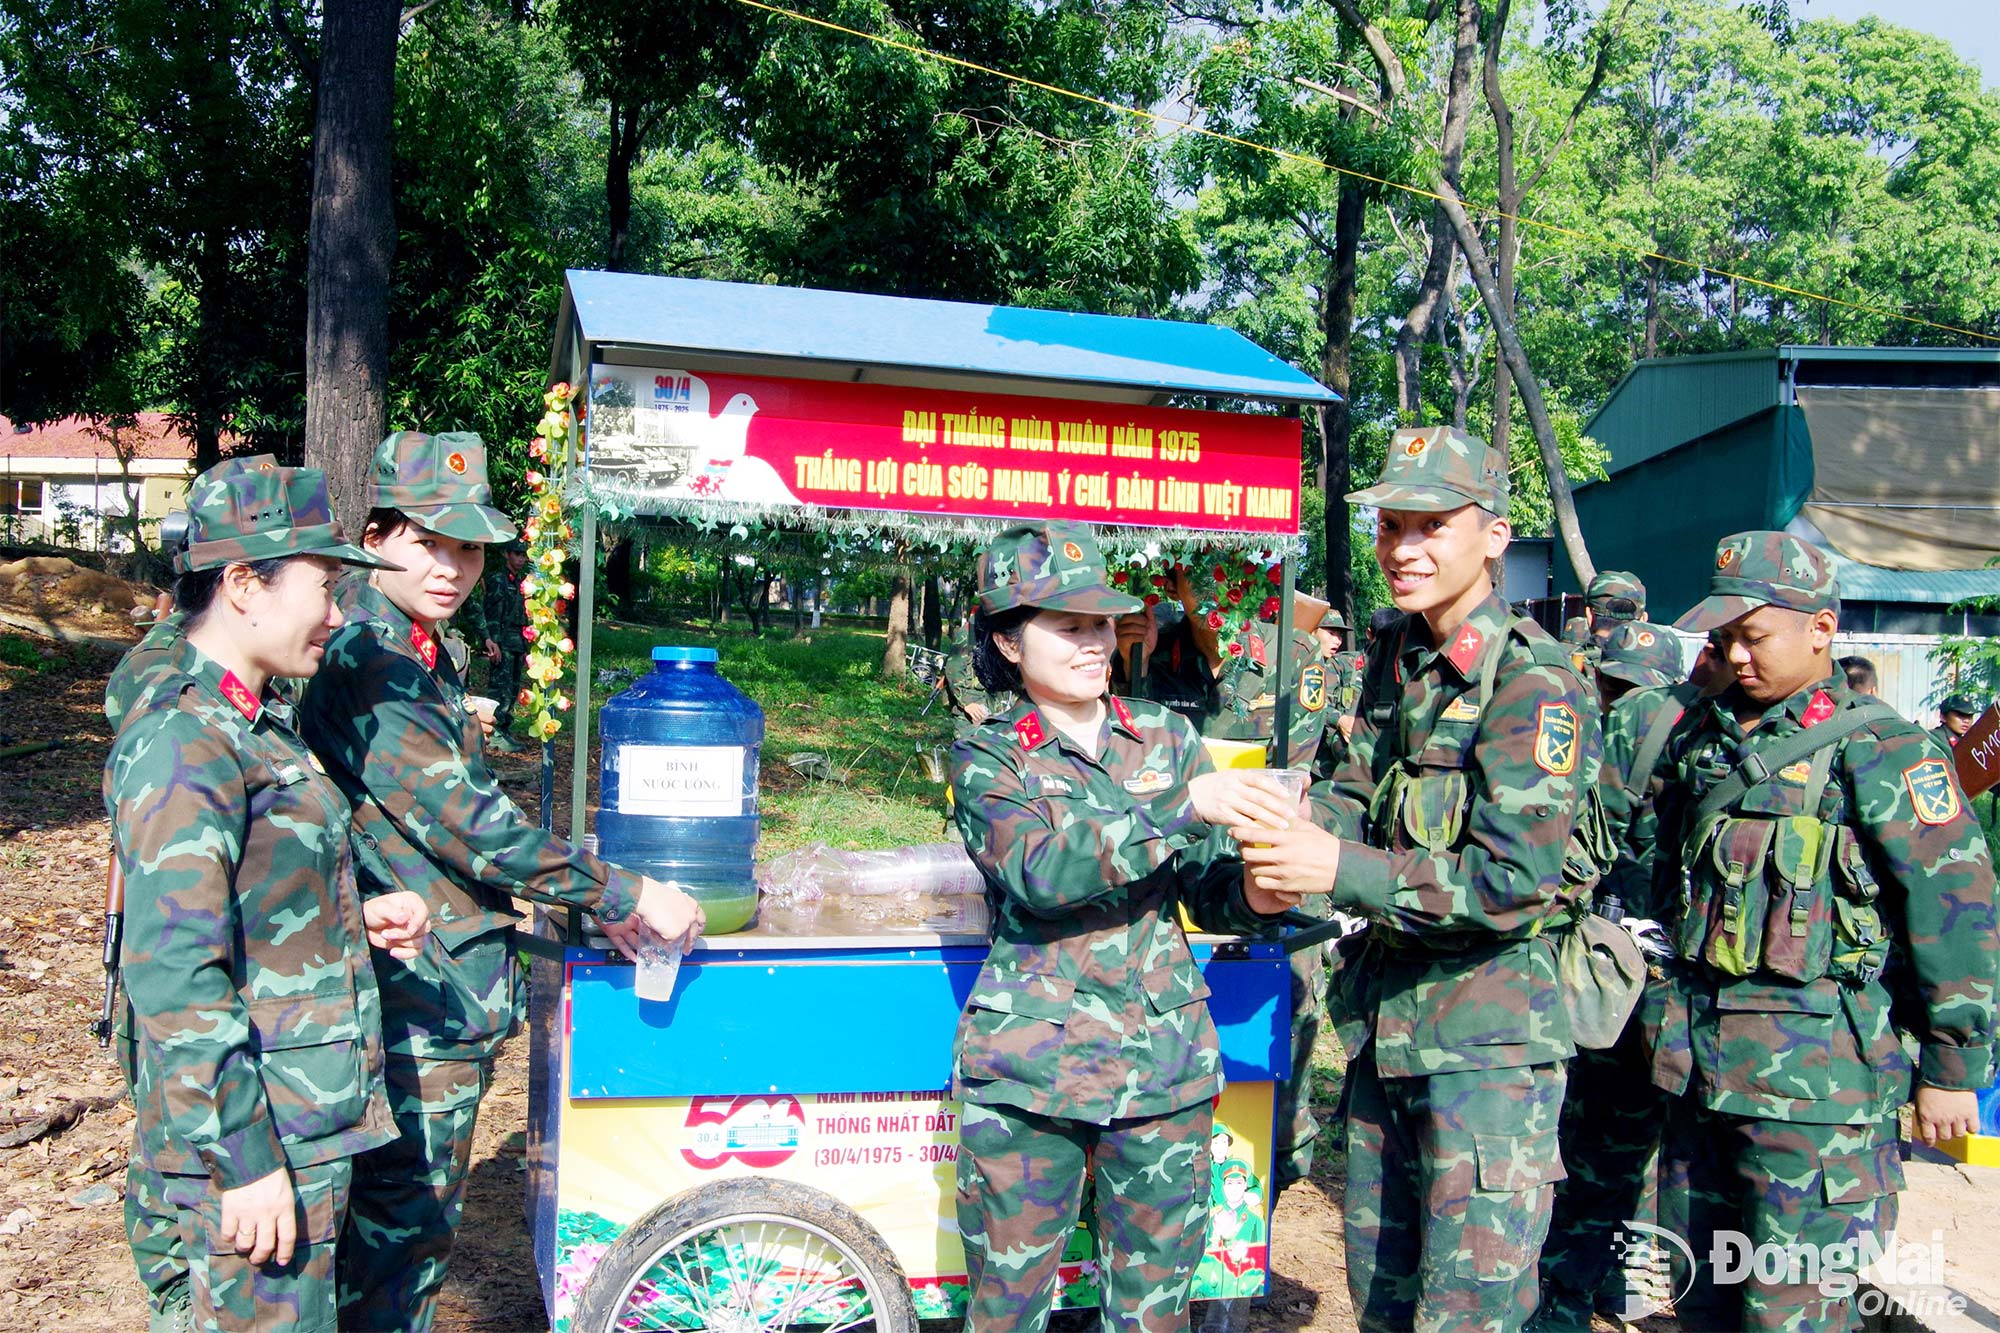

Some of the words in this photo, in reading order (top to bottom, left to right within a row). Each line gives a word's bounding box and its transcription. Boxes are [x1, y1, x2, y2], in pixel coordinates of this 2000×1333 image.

[654, 375, 690, 401] 30/4
[903, 410, 936, 449] ĐẠI
[942, 406, 1005, 449] THẮNG
[1010, 415, 1054, 453] MÙA
[1057, 419, 1107, 456] XUÂN
[1112, 421, 1153, 459] NĂM
[1158, 429, 1200, 463] 1975
[795, 448, 862, 493] THẮNG
[867, 457, 898, 499] LỢI
[903, 456, 943, 497] CỦA
[948, 462, 988, 500] SỨC
[993, 468, 1053, 507] MẠNH,
[1057, 468, 1071, 505] Ý
[1074, 471, 1111, 511] CHÍ,
[1116, 471, 1154, 511] BẢN
[1158, 476, 1199, 514] LĨNH
[1203, 479, 1243, 521] VIỆT
[1246, 486, 1292, 520] NAM!
[666, 758, 698, 771] BÌNH
[642, 776, 680, 789] NƯỚC
[684, 776, 720, 790] UỐNG
[816, 1110, 871, 1134] THỐNG
[877, 1109, 920, 1133] NHẤT
[925, 1108, 956, 1131] ĐẤT
[815, 1147, 902, 1167] (30/4/1975
